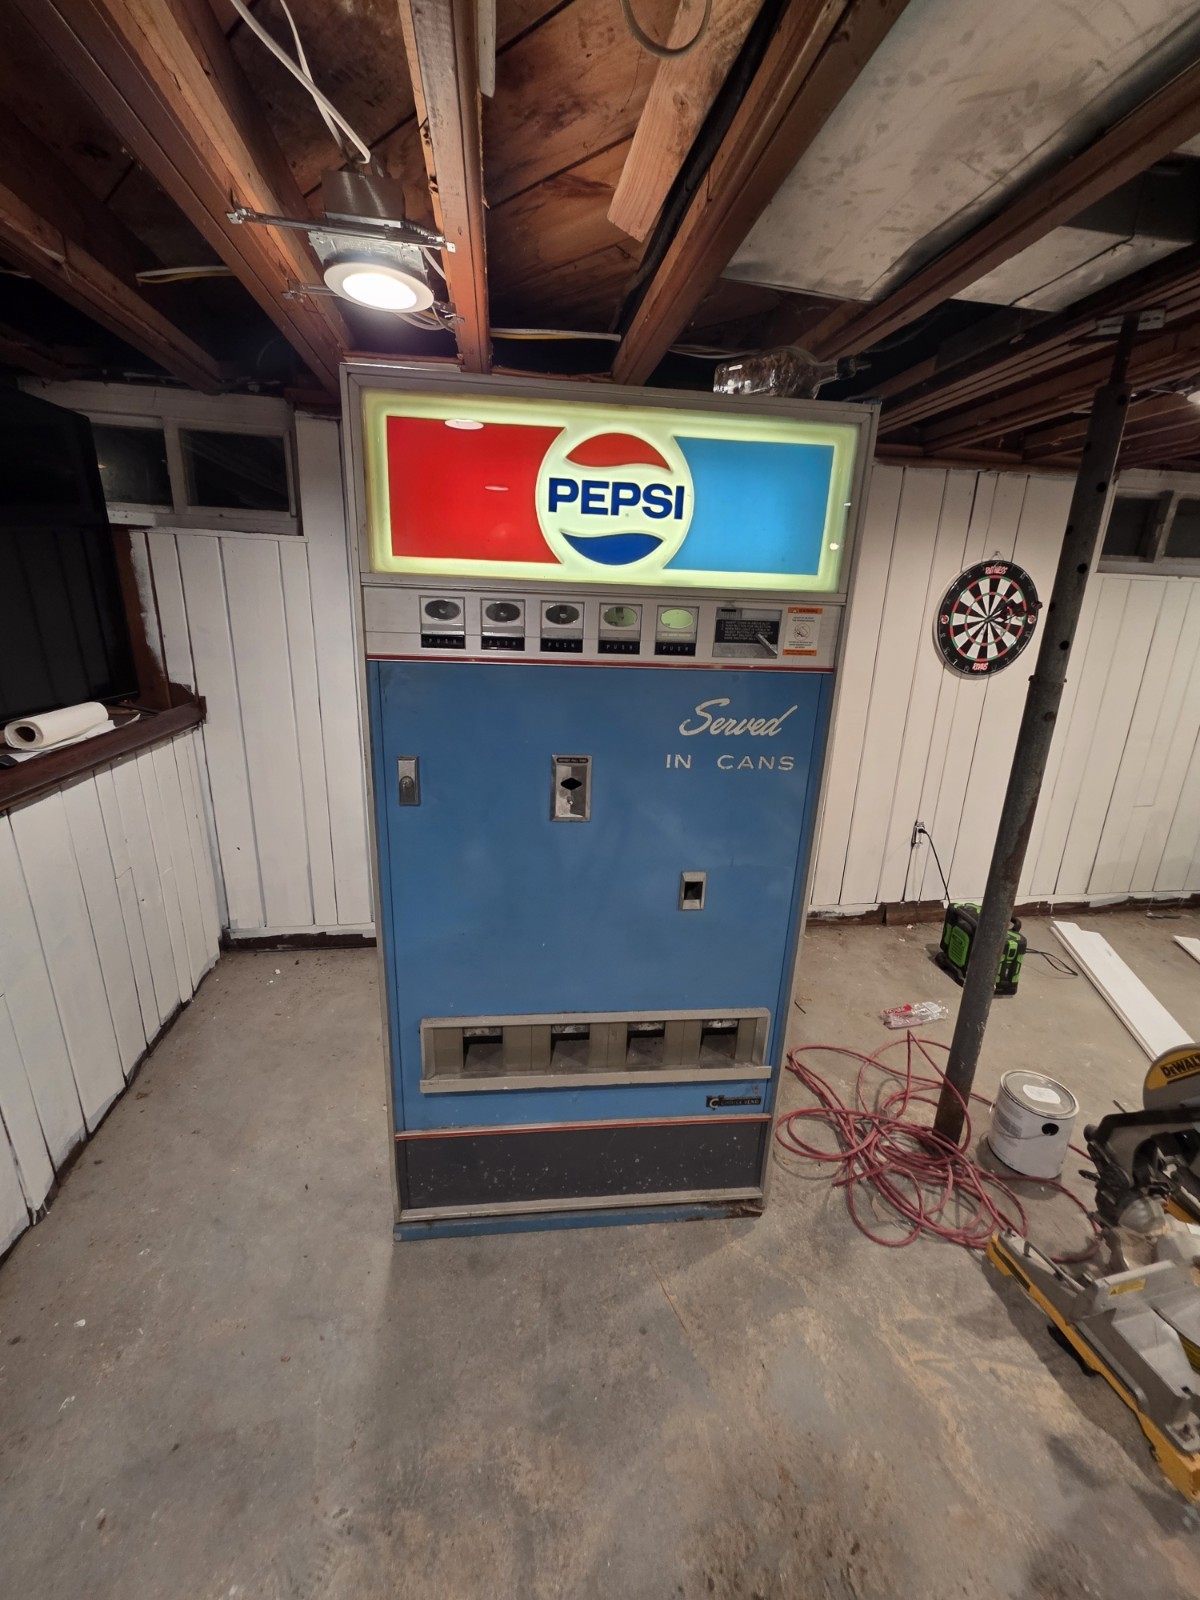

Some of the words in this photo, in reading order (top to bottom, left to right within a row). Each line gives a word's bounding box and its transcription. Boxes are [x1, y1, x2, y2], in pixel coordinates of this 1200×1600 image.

[548, 477, 685, 520] PEPSI
[679, 698, 798, 736] Served
[666, 754, 692, 769] IN
[717, 755, 795, 770] CANS
